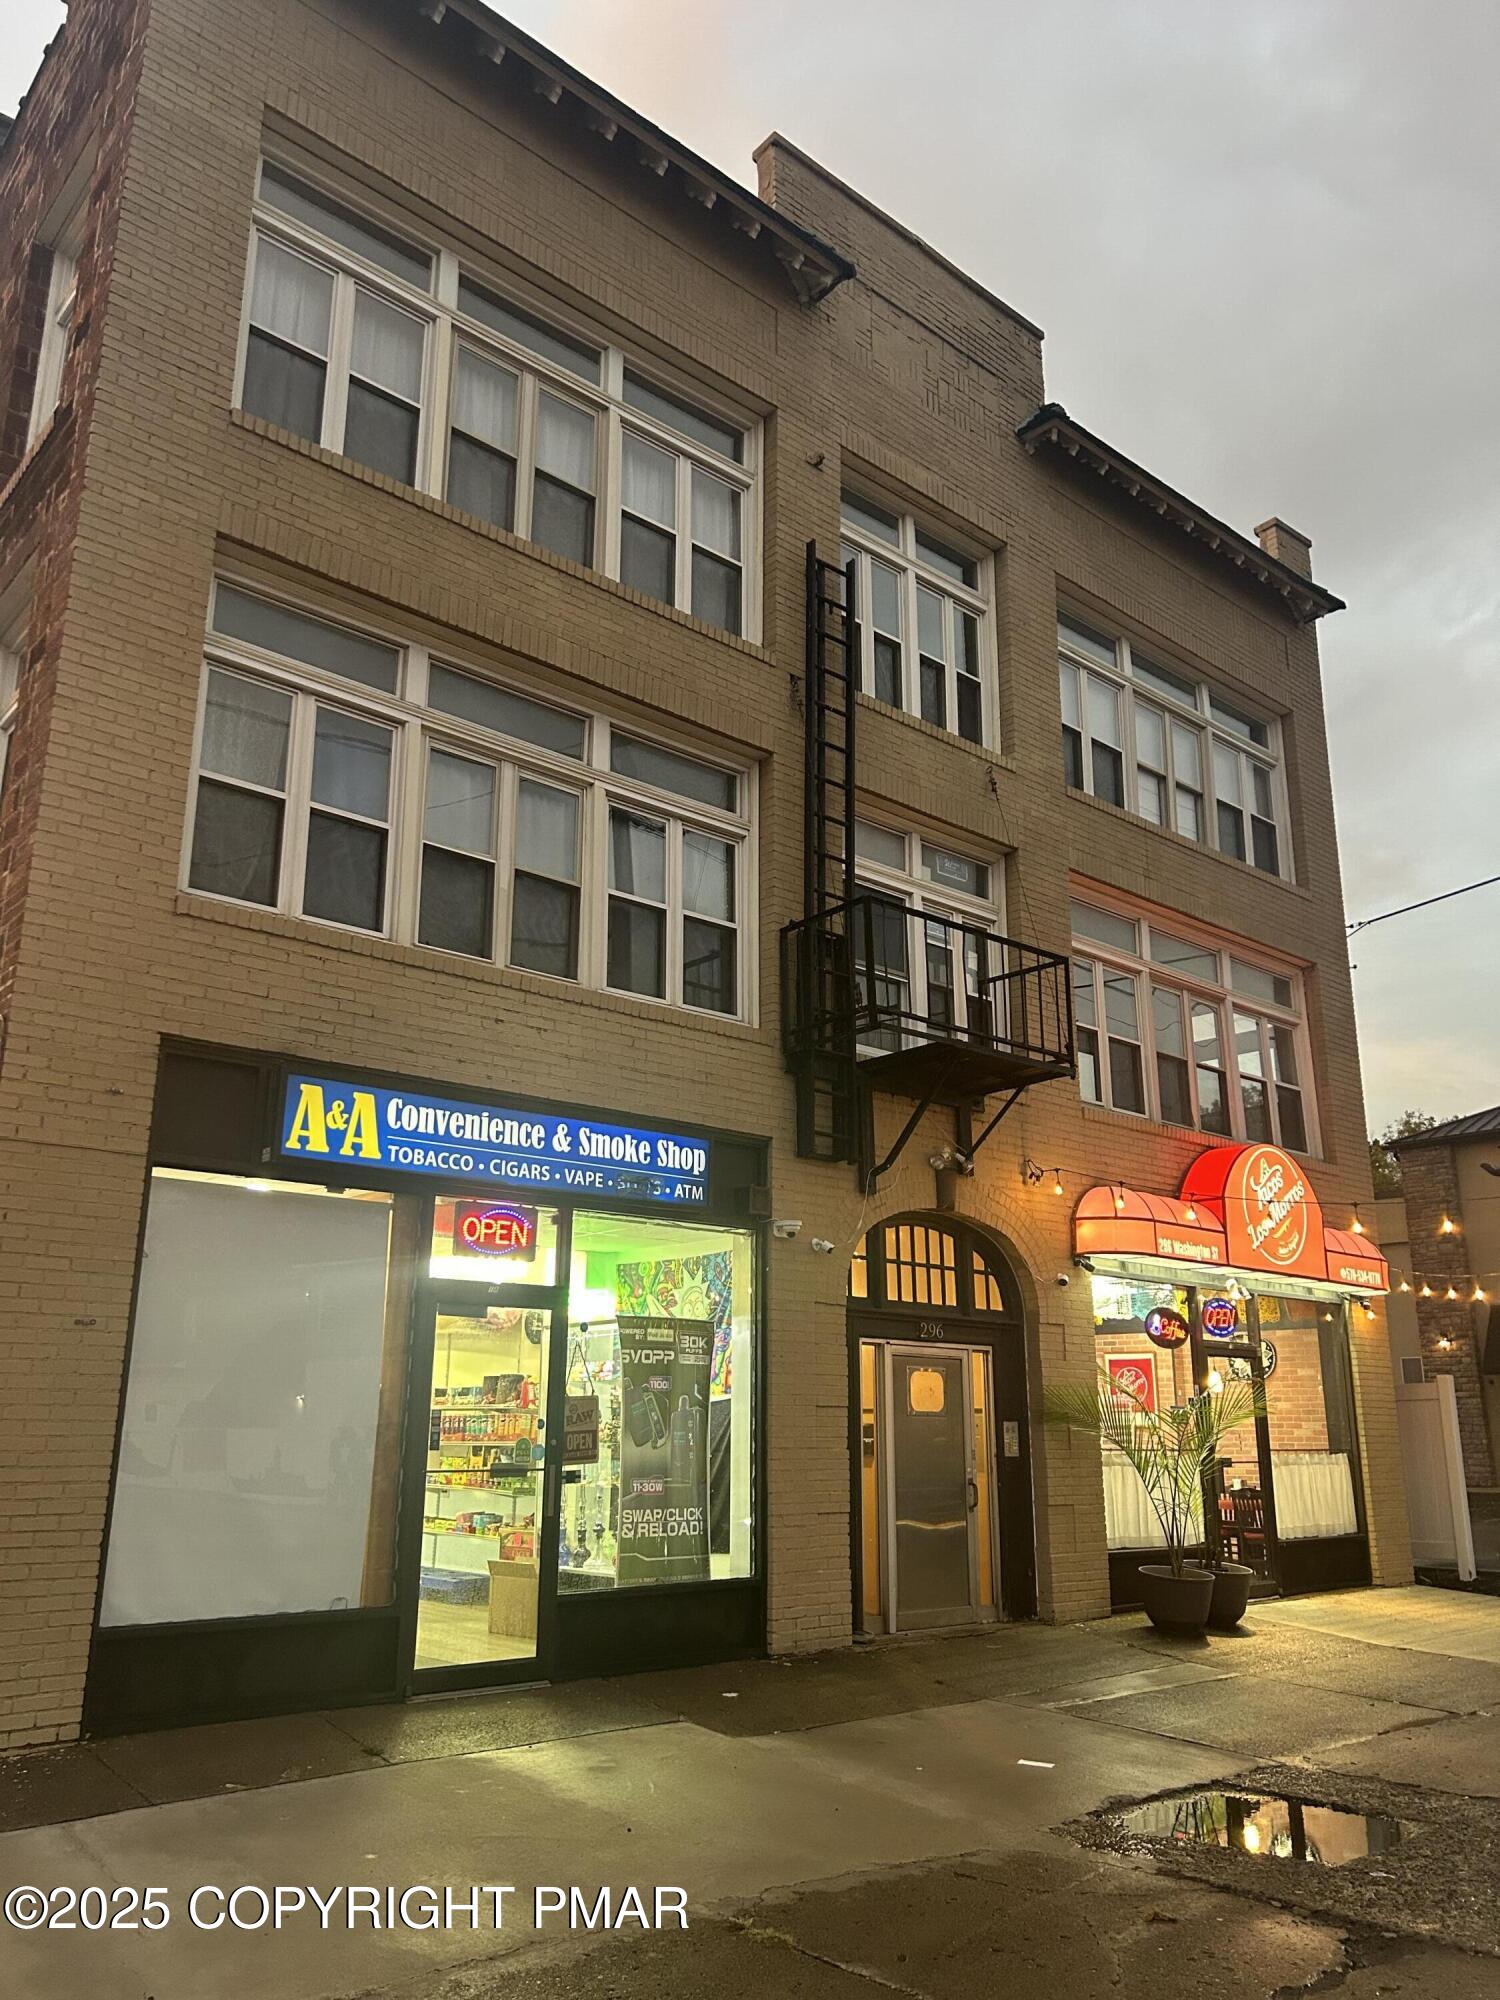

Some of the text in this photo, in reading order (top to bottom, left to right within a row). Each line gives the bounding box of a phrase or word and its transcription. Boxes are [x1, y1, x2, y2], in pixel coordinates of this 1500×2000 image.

[285, 1083, 382, 1160] A&A
[387, 1097, 706, 1176] Convenience & Smoke Shop
[387, 1145, 474, 1171] TOBACCO
[489, 1159, 551, 1181] CIGARS
[564, 1168, 604, 1188] VAPE
[674, 1183, 704, 1201] ATM
[462, 1217, 528, 1247] OPEN
[1206, 1308, 1236, 1328] OPEN
[920, 1321, 944, 1339] 296
[680, 1335, 708, 1349] 30K
[566, 1409, 594, 1427] RAW
[566, 1433, 593, 1451] OPEN
[622, 1507, 703, 1523] SWAP/CLICK
[621, 1521, 704, 1539] & RELOAD!
